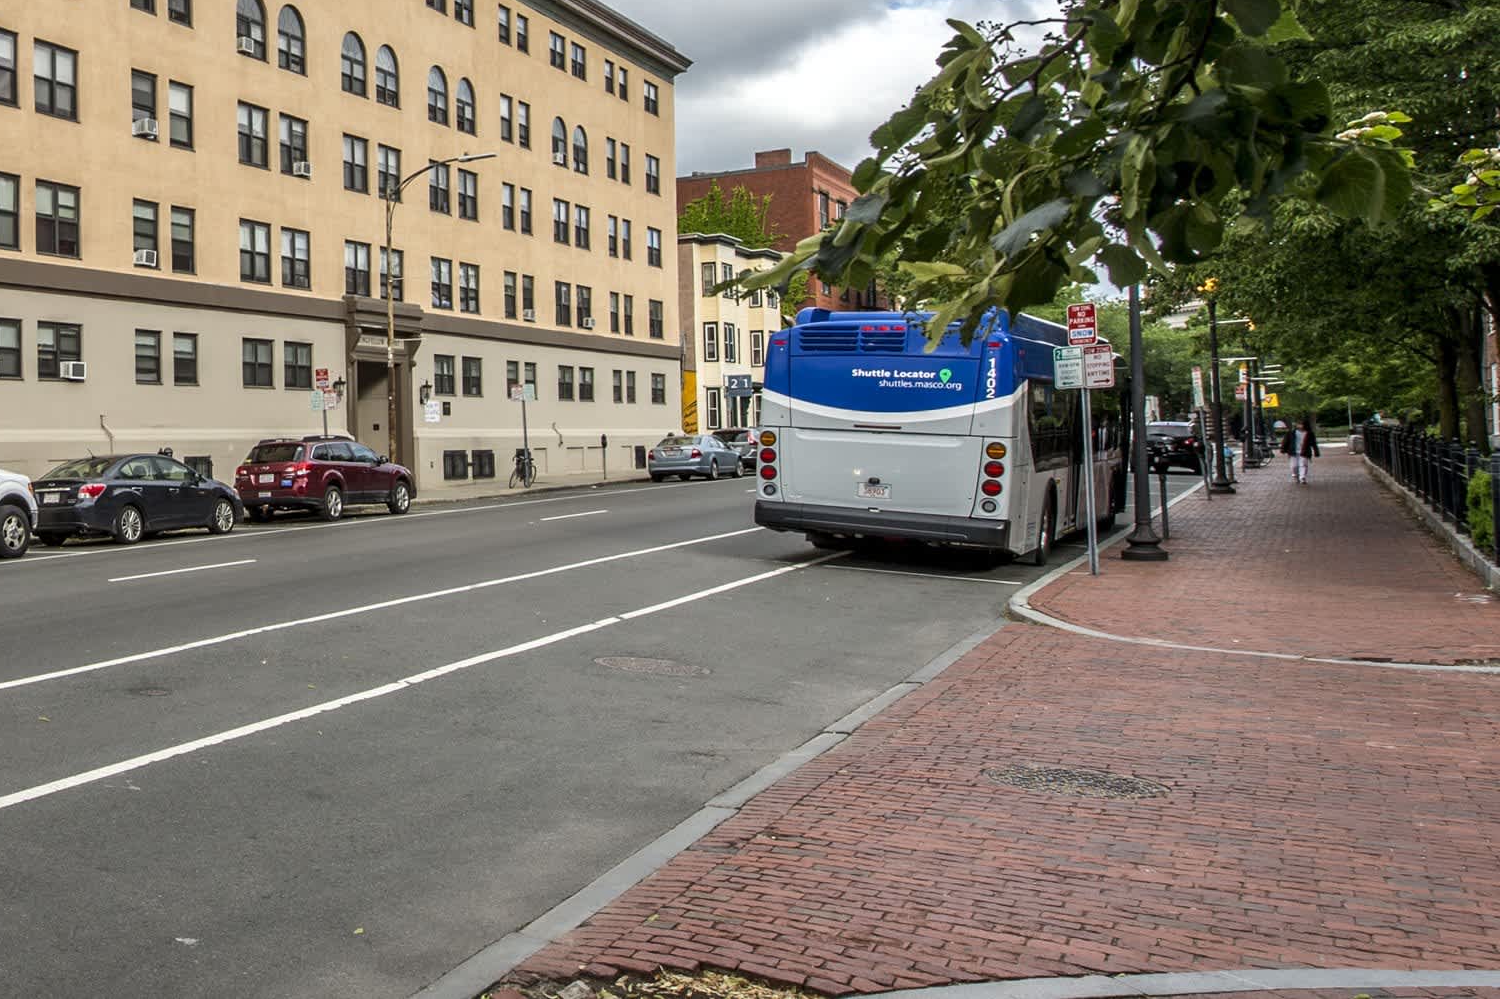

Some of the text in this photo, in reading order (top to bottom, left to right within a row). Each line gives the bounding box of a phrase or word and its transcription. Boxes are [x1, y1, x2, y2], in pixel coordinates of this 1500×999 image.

[1071, 329, 1093, 337] SNOW
[851, 368, 936, 379] Shuttle Locator
[986, 357, 997, 399] 1402
[878, 379, 963, 392] shuttles.masco.org
